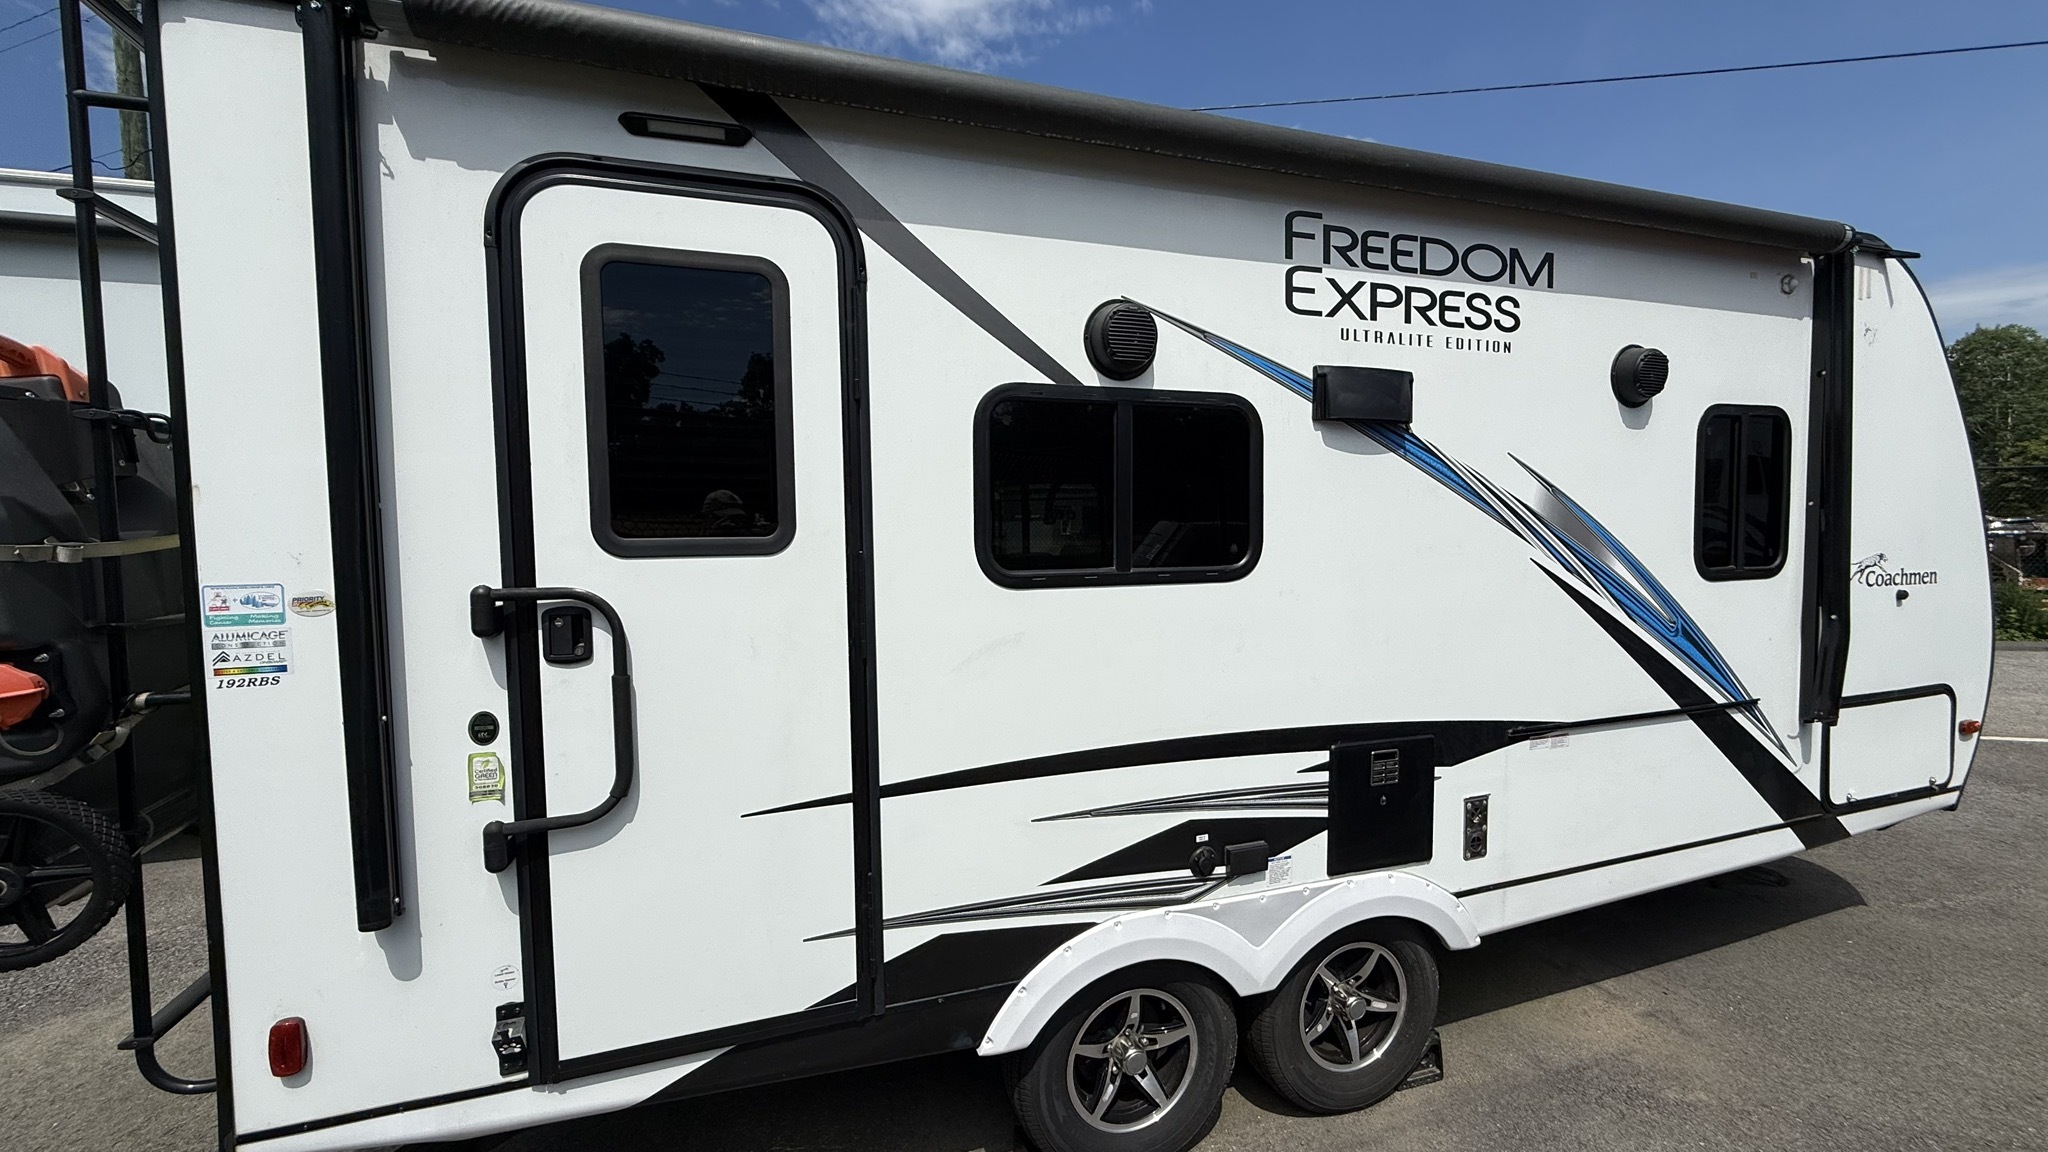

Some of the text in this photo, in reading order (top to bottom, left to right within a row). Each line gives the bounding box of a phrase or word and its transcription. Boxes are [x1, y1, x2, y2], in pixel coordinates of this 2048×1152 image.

[1284, 210, 1555, 289] FREEDOM
[1285, 265, 1521, 333] EXPRESS
[1339, 327, 1512, 354] ULTRALITE EDITION
[1865, 567, 1938, 587] Coachmen
[292, 595, 325, 603] PRIORITY
[211, 630, 288, 642] ALUMICAGE
[232, 652, 286, 662] AZDEL
[216, 676, 281, 689] 192RBS
